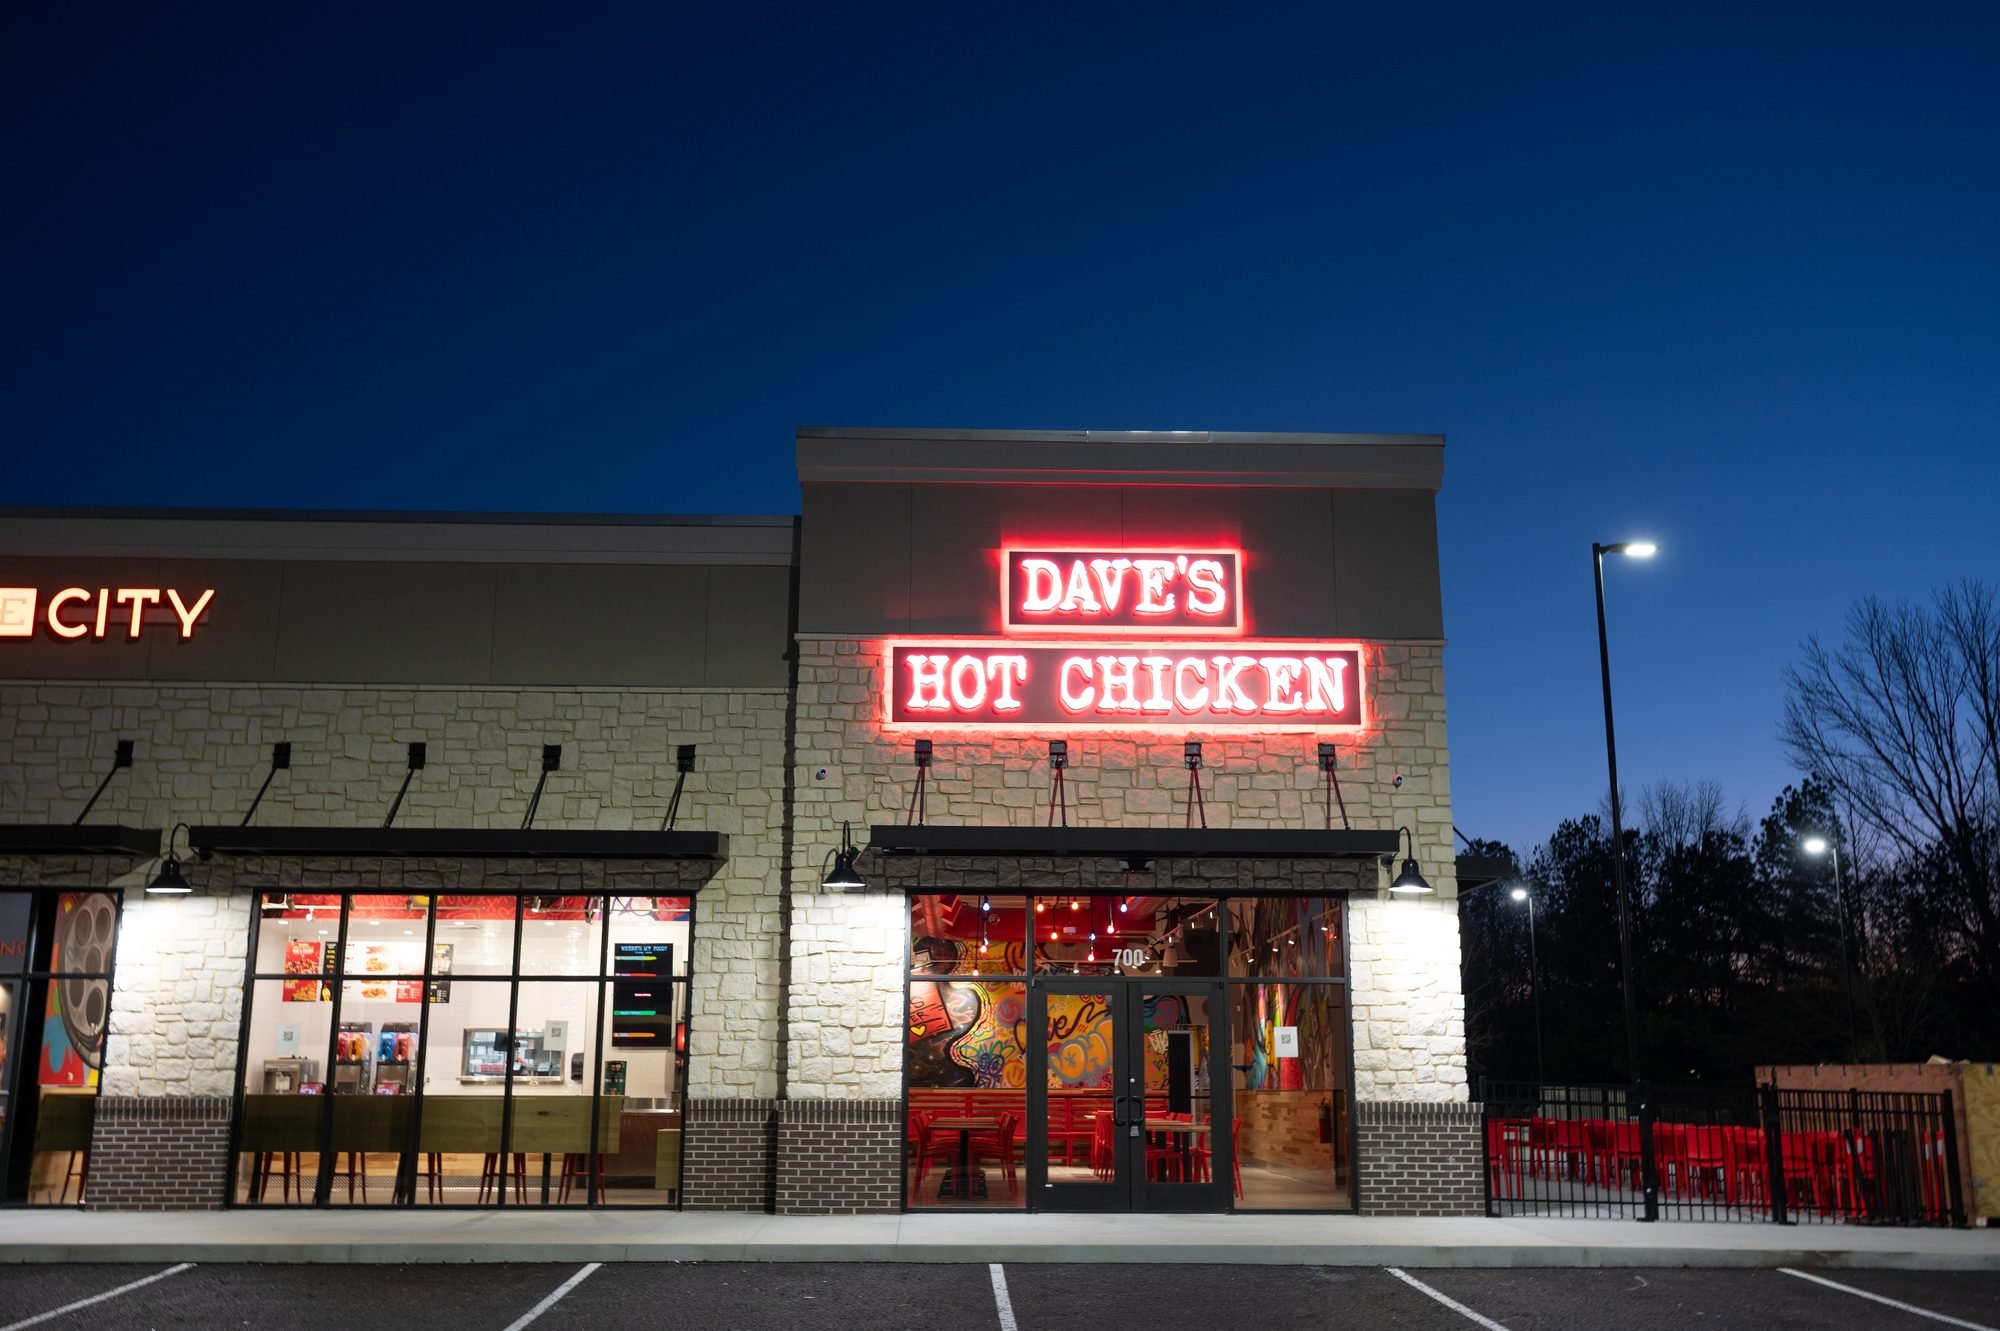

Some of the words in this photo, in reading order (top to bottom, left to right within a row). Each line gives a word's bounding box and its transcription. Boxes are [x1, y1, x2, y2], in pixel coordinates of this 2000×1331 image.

[1021, 555, 1226, 614] DAVE'S
[47, 587, 215, 638] CITY
[906, 654, 1028, 711] HOT
[1060, 656, 1349, 714] CHICKEN
[1112, 948, 1144, 967] 700
